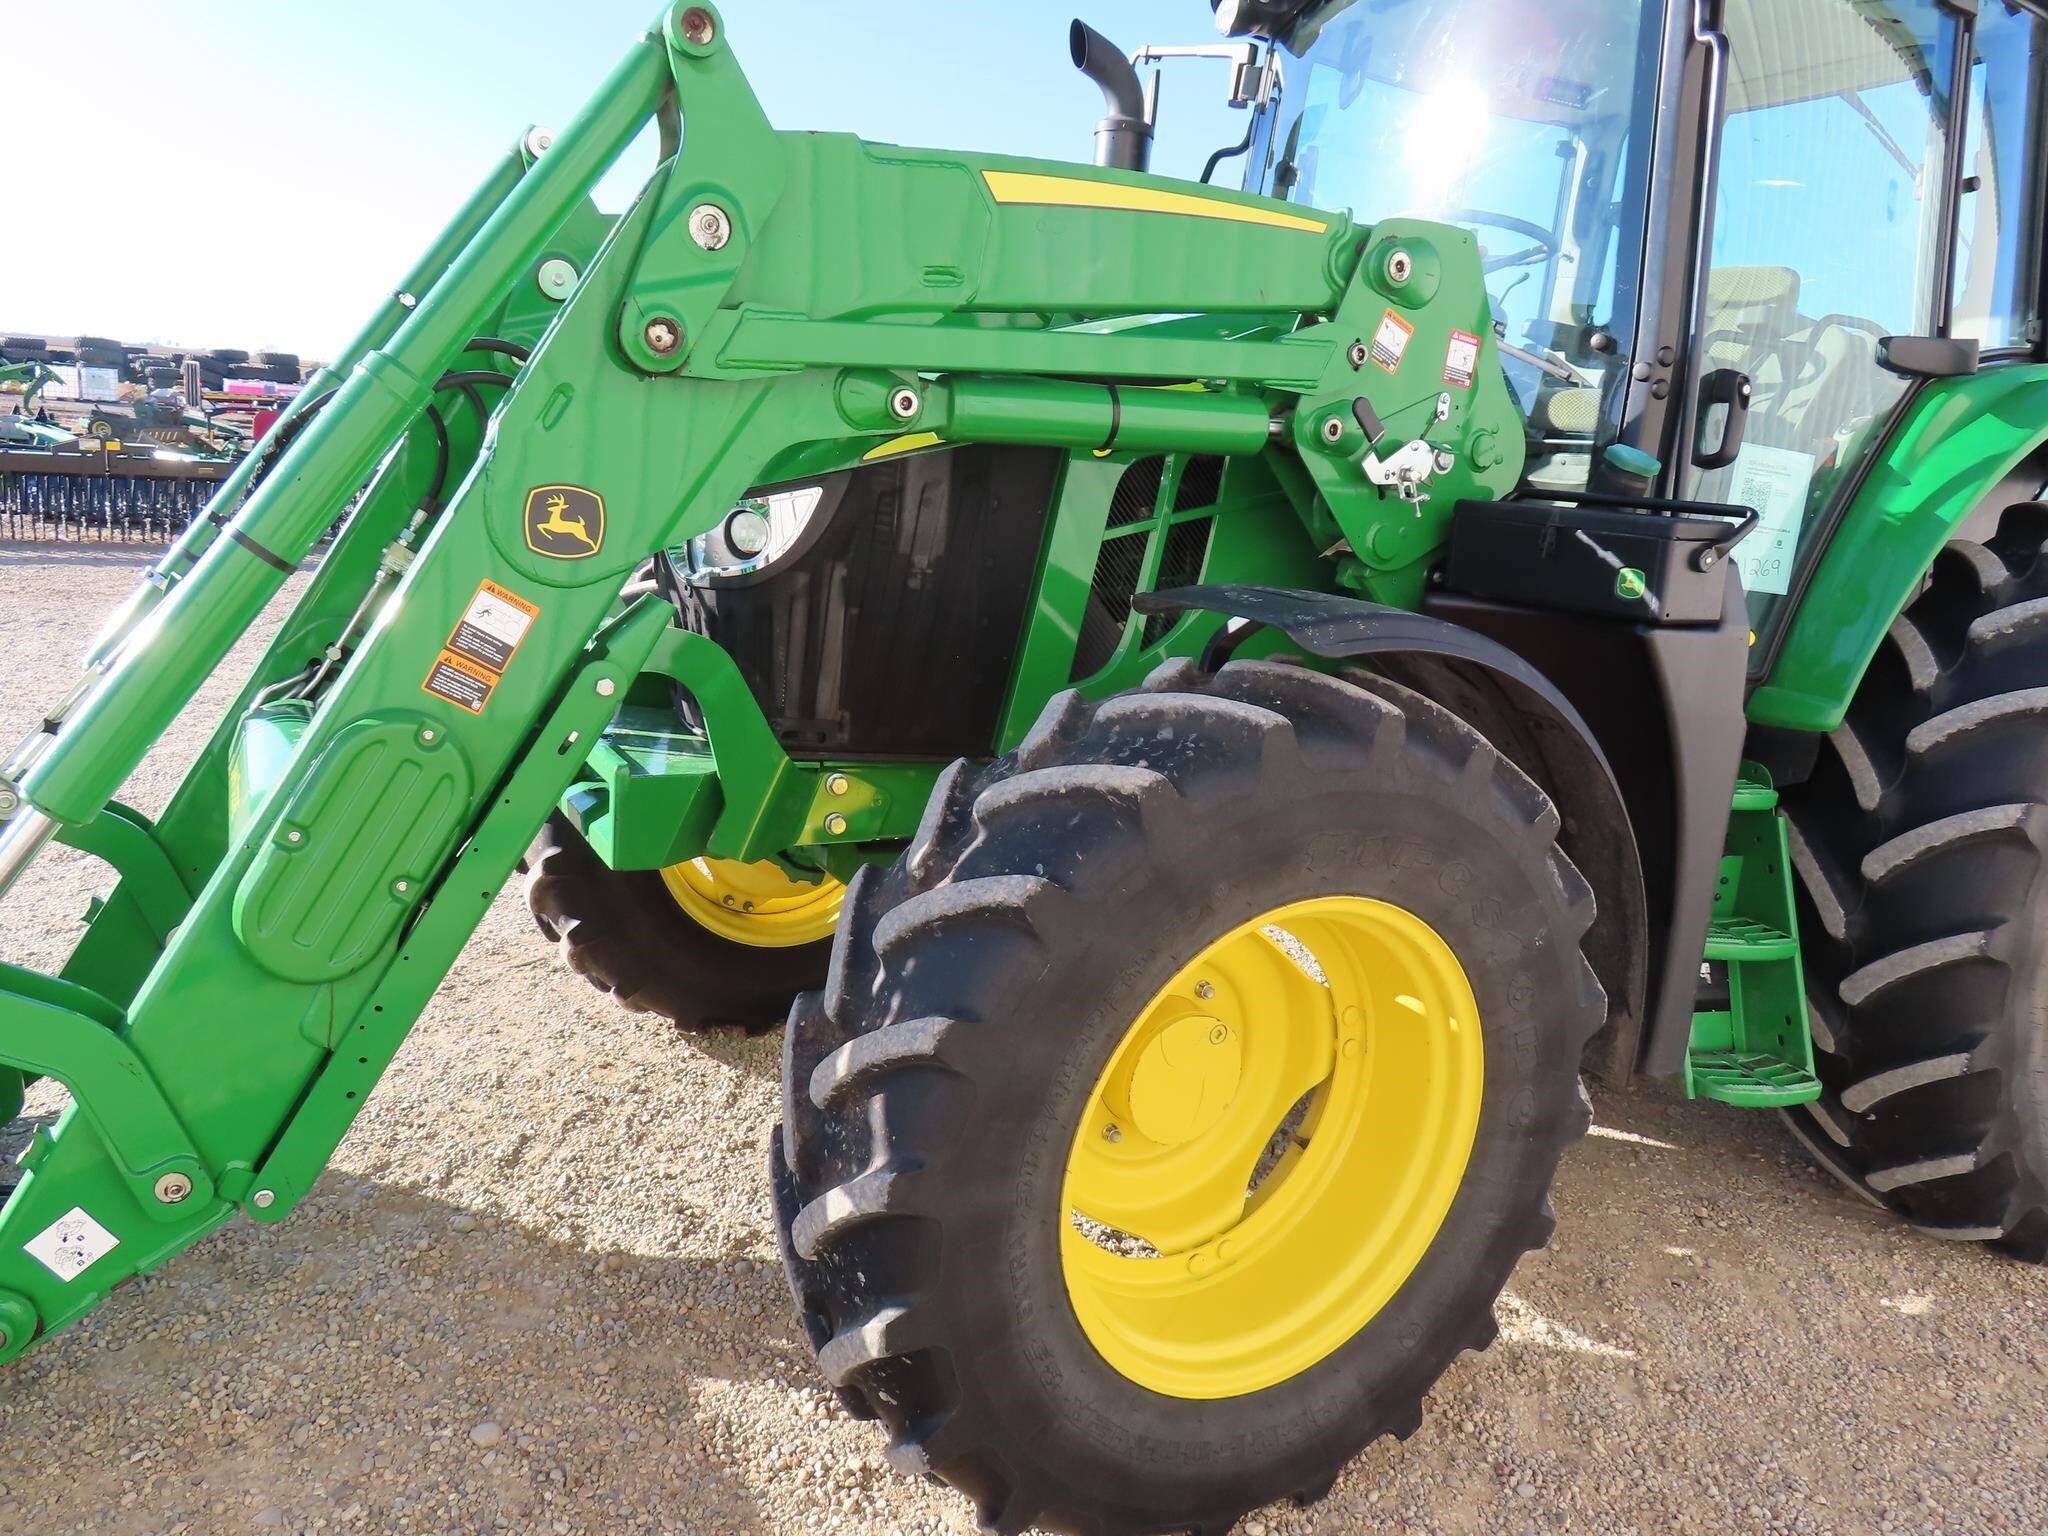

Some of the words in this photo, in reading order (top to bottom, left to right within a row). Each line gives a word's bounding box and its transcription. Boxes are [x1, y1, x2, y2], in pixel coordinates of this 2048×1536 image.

[1741, 558, 1781, 578] 1269
[496, 589, 532, 613] WARNING
[455, 660, 492, 682] WARNING
